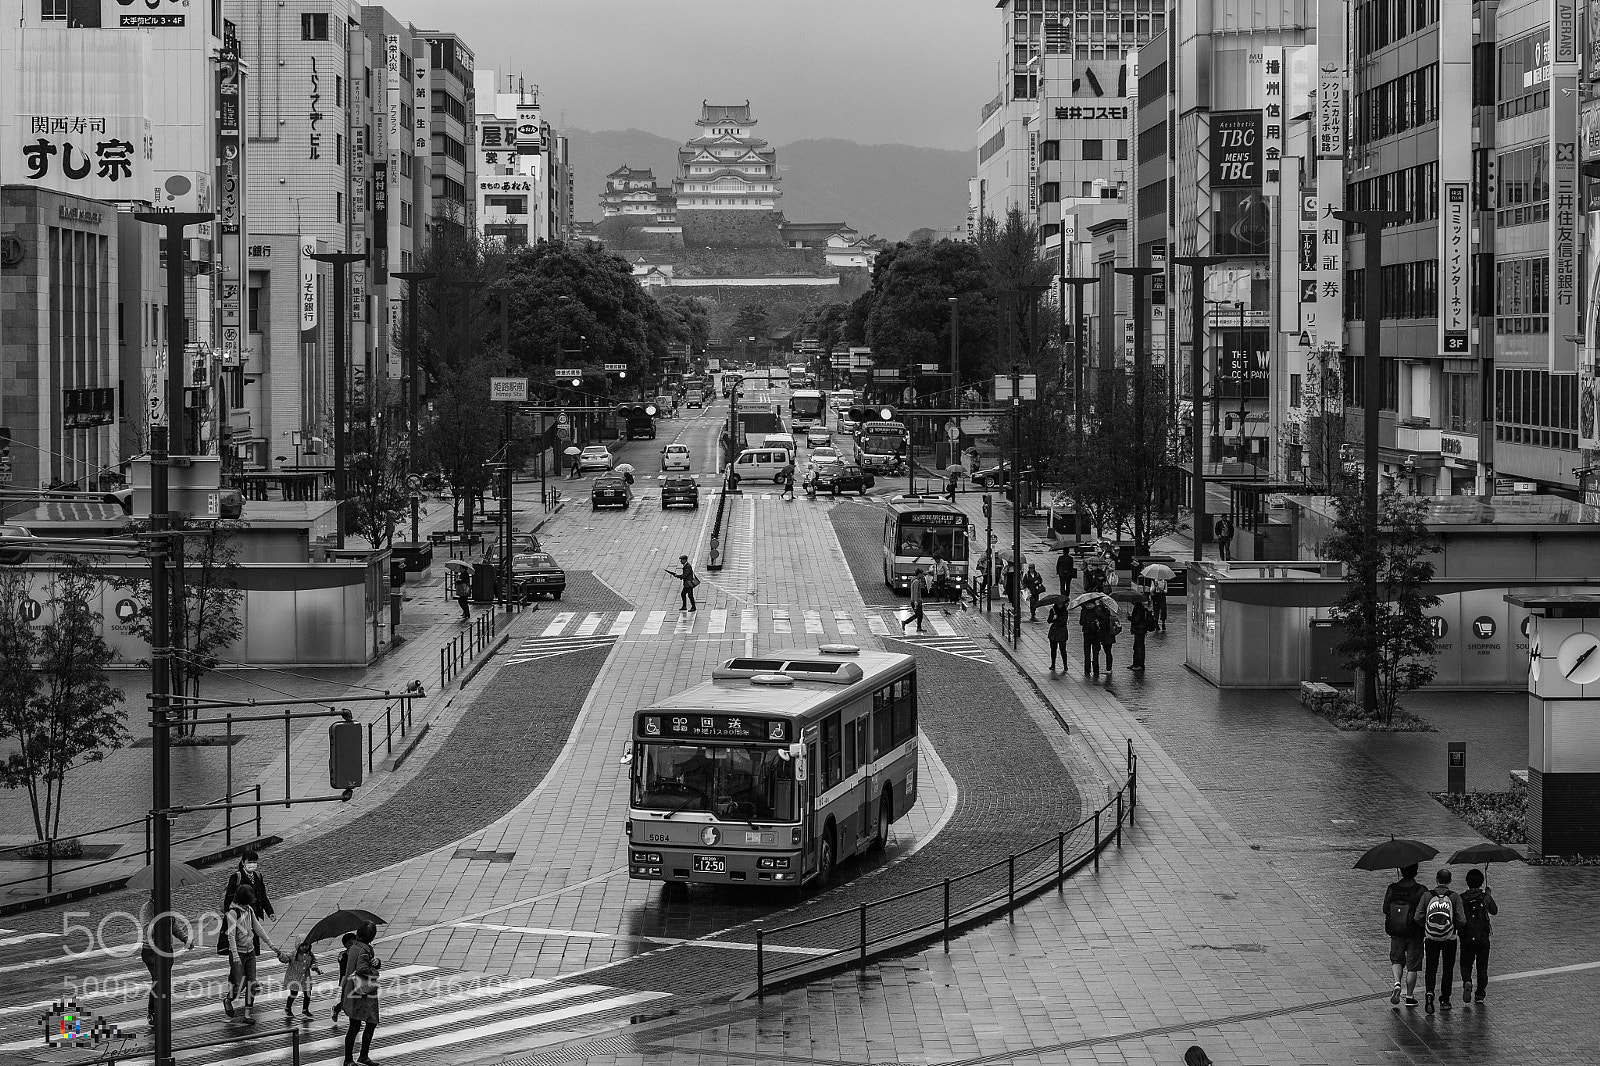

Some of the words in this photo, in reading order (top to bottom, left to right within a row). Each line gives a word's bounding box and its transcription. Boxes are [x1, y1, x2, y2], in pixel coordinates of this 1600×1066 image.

[1559, 5, 1572, 56] ADERANS
[388, 35, 398, 72] 共栄火災
[415, 87, 426, 148] 第一生命
[1266, 59, 1281, 184] 播州信用金庫
[1321, 82, 1331, 132] シーズ・ラボ
[1331, 82, 1341, 152] クリニカルサロン
[31, 116, 106, 134] 関西寿司
[1218, 128, 1255, 148] TBC
[1224, 152, 1250, 162] MEN'S
[1321, 133, 1331, 152] 姫路
[22, 138, 135, 182] すし宗
[1219, 161, 1255, 180] TBC
[480, 182, 500, 190] きもの
[1321, 203, 1340, 298] 大和証券
[1557, 180, 1574, 305] 三井住友信託銀行
[1451, 204, 1462, 328] コミック・インターネット
[303, 272, 314, 322] りそな銀行
[1231, 350, 1248, 359] THE
[1448, 338, 1464, 349] 3F
[1231, 360, 1249, 369] SUT
[149, 396, 160, 426] すし
[649, 833, 671, 843] 5084
